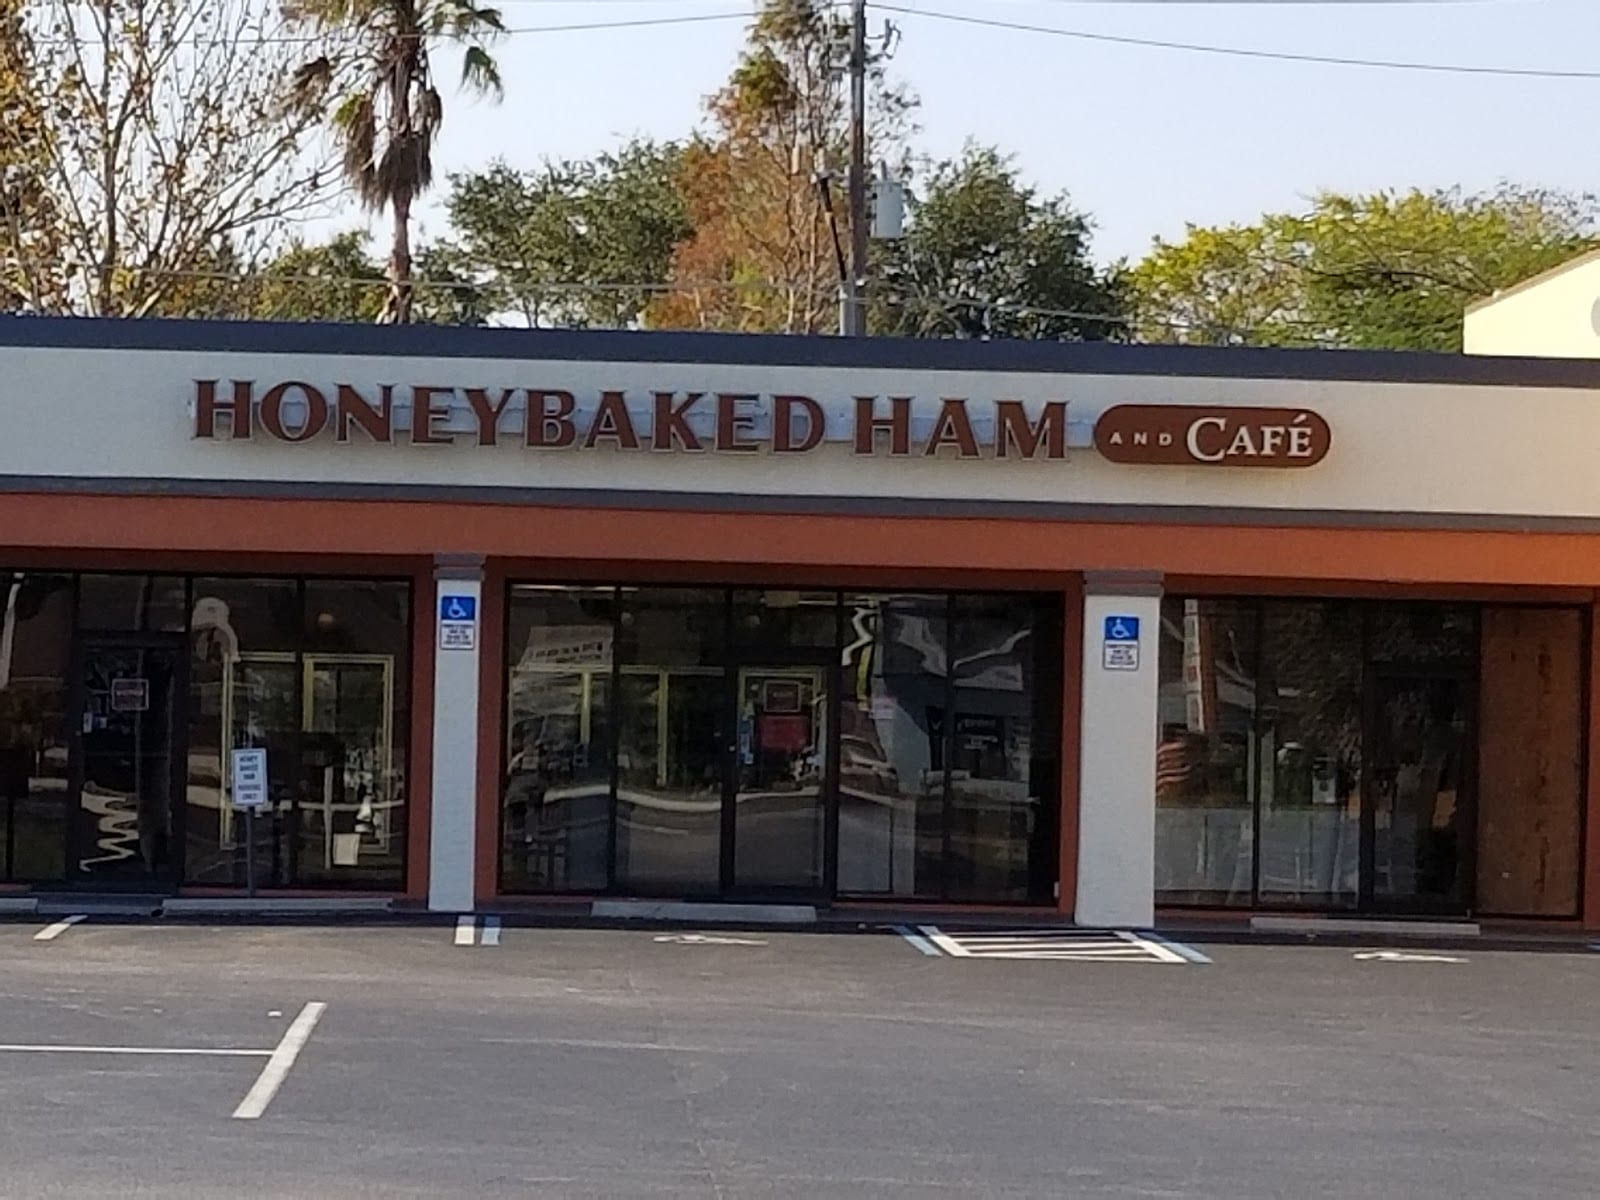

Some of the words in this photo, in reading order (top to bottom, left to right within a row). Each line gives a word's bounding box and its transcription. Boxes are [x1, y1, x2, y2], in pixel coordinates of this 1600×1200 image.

[192, 379, 826, 455] HONEYBAKED
[853, 395, 1069, 461] HAM
[1109, 431, 1173, 446] AND
[1187, 413, 1313, 462] CAFÉ
